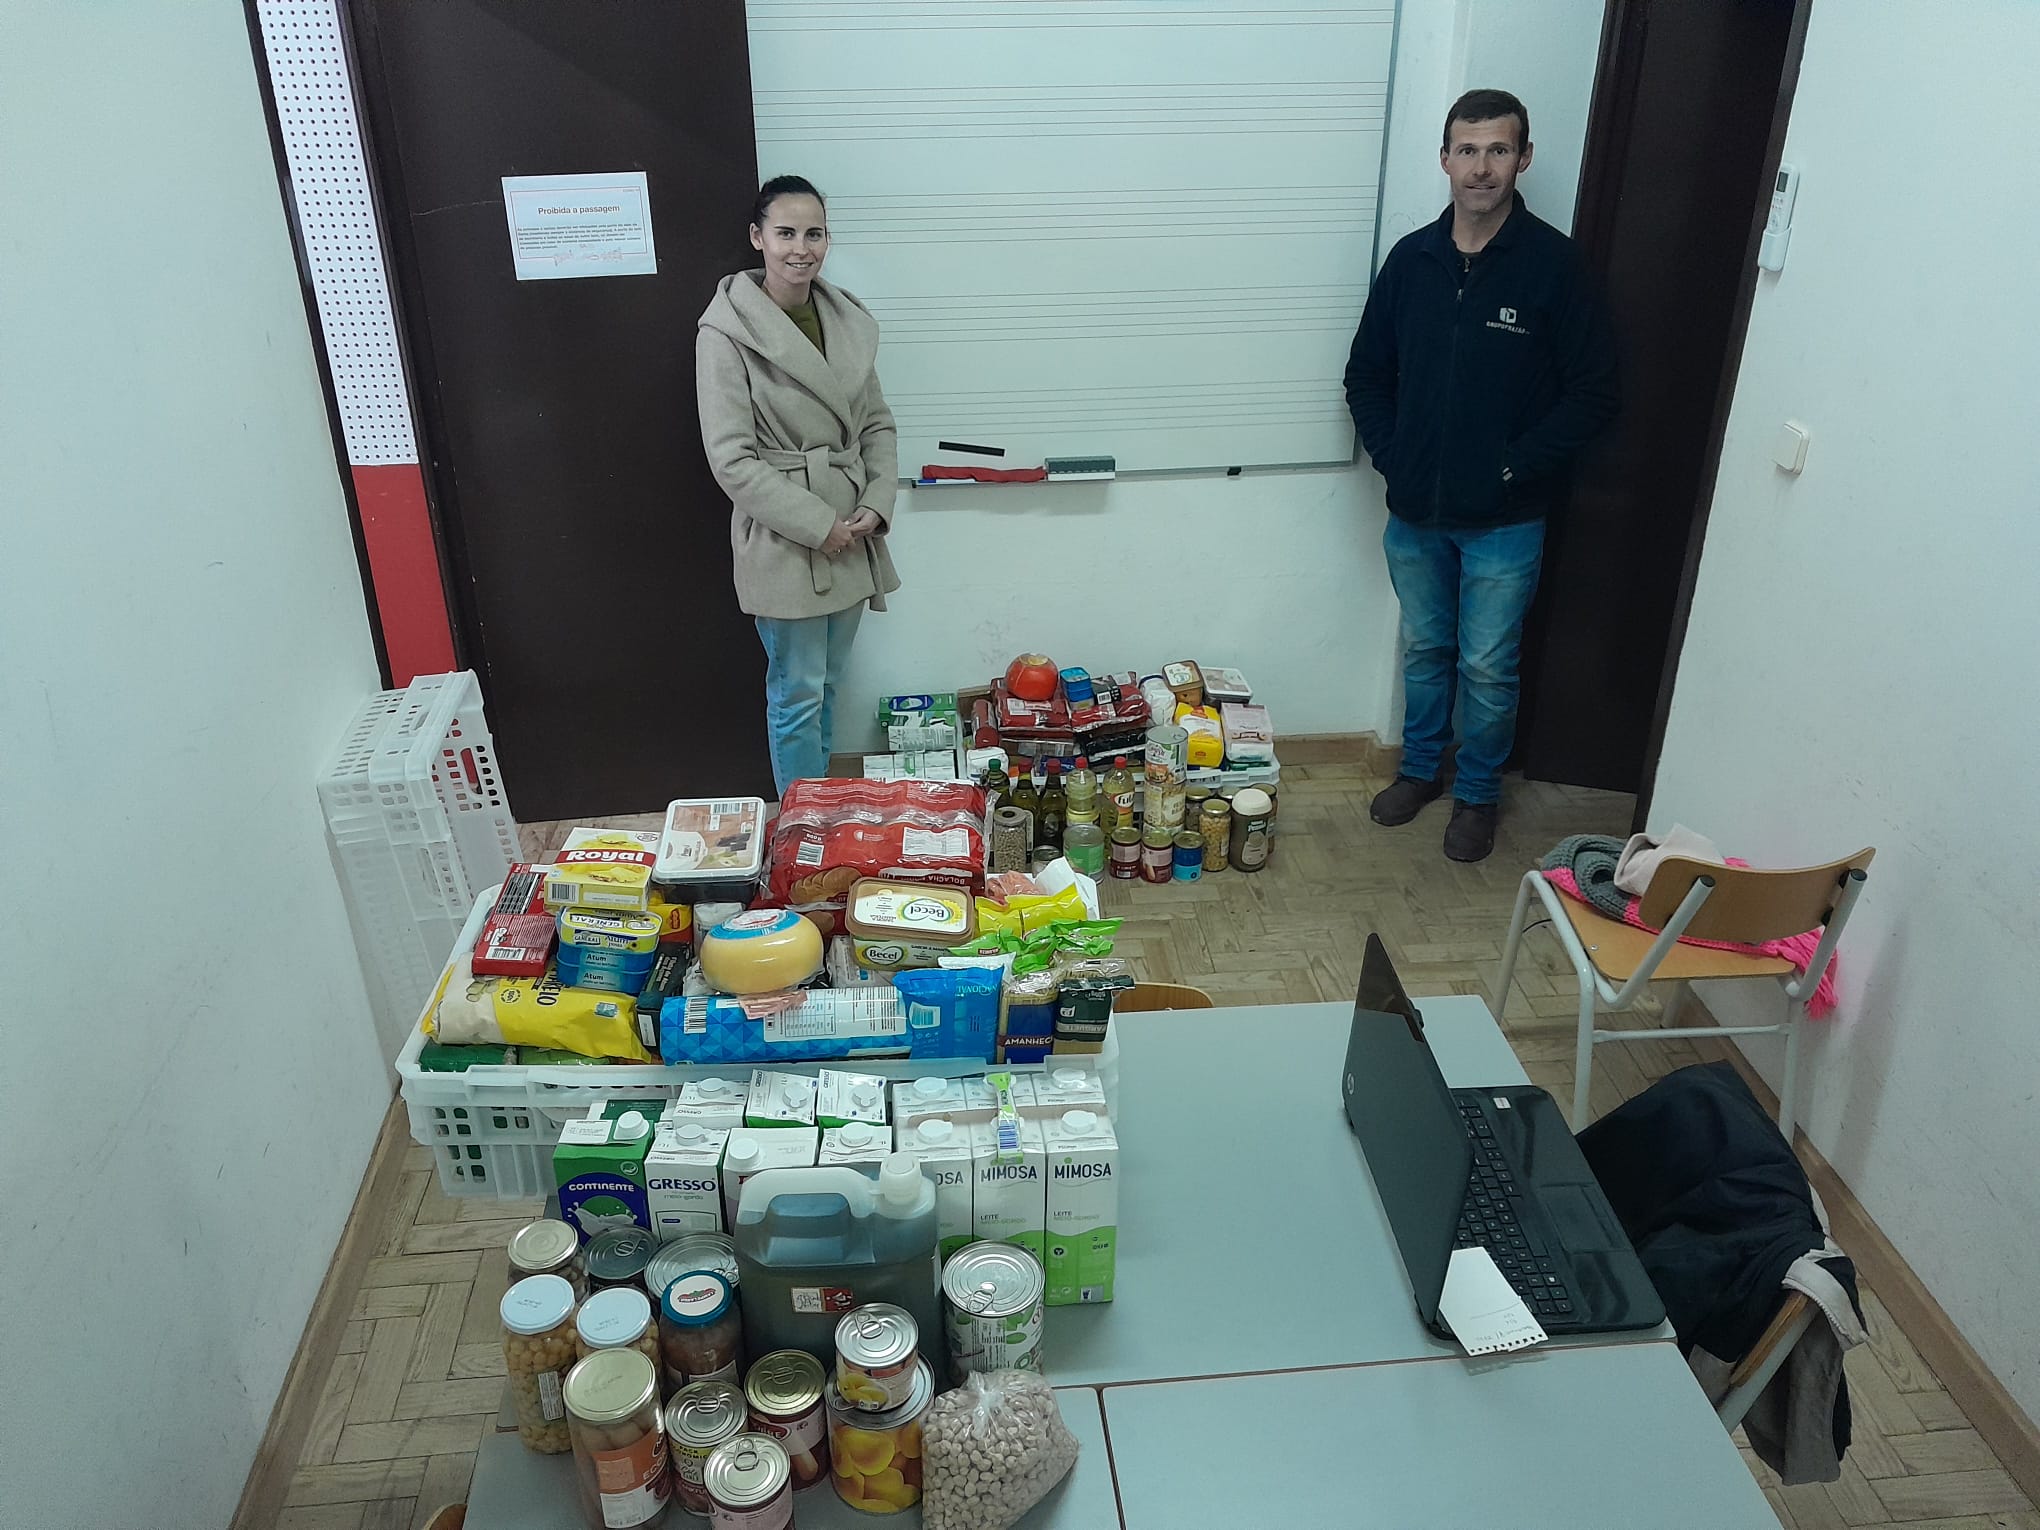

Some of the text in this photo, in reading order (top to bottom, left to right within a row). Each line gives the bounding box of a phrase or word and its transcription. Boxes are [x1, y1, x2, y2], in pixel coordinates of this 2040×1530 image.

[537, 207, 571, 215] Proibida
[579, 205, 620, 215] passagem
[566, 851, 645, 862] Royal
[928, 875, 965, 885] BOLACHA
[910, 905, 945, 918] Becel
[575, 915, 620, 927] GENERAL
[586, 953, 607, 962] Atum
[869, 949, 898, 960] Becel
[584, 972, 604, 981] Atum
[980, 1165, 1037, 1183] MIMOSA
[1054, 1163, 1112, 1180] MIMOSA
[936, 1171, 964, 1186] OSA
[568, 1182, 635, 1193] CONTINENTE
[648, 1178, 716, 1192] GRESSO
[980, 1213, 999, 1221] LEITE
[1053, 1210, 1073, 1218] LEITE
